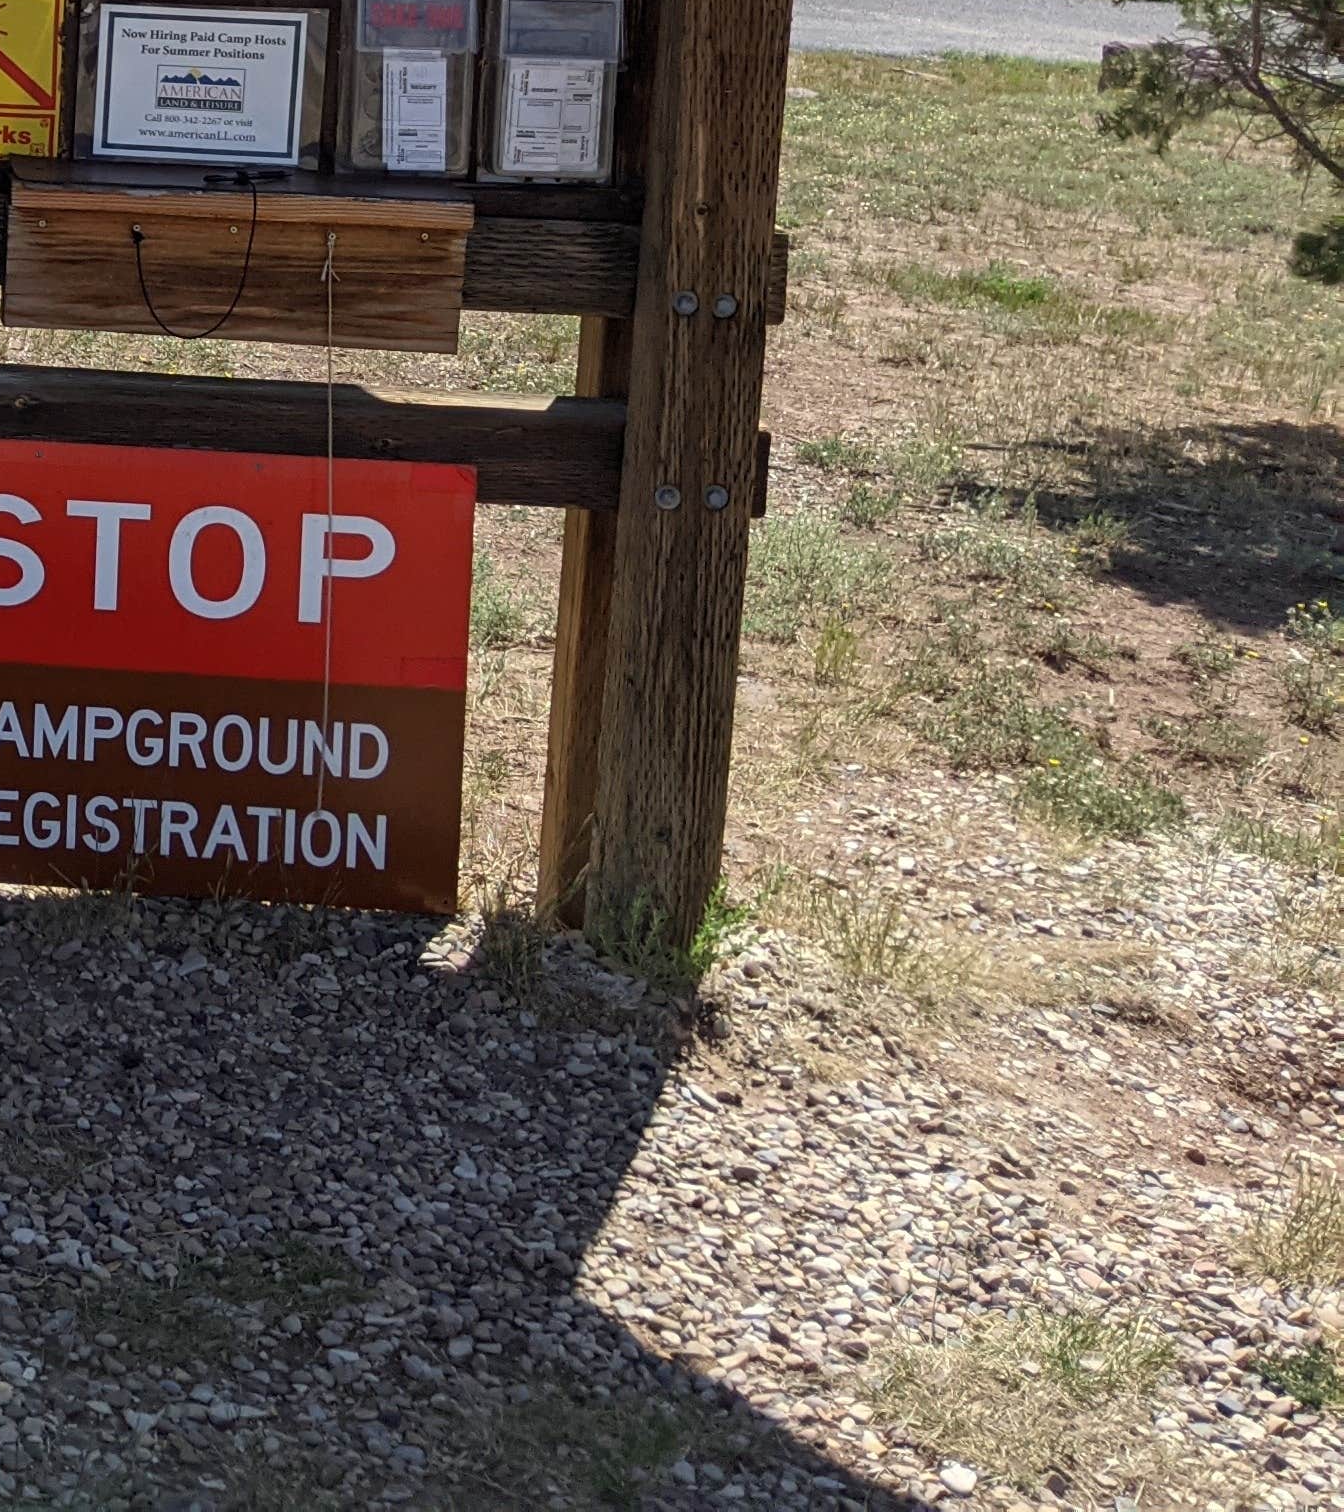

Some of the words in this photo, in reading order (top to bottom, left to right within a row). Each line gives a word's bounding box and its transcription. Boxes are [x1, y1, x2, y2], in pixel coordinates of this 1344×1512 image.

[122, 28, 147, 39] Now
[150, 29, 187, 43] Hiring
[190, 31, 215, 43] Paid
[218, 33, 252, 46] Camp
[255, 35, 287, 46] Hosts
[141, 44, 160, 55] For
[162, 46, 211, 57] Summer
[214, 48, 265, 61] Positions
[159, 85, 242, 100] AMERICAN
[160, 98, 187, 108] LAND
[190, 100, 199, 109] &
[200, 100, 241, 111] LEISURE
[144, 113, 162, 122] Call
[164, 114, 222, 125] 800-342-2267
[235, 118, 253, 127] visit
[138, 128, 256, 143] www.americanLL.com
